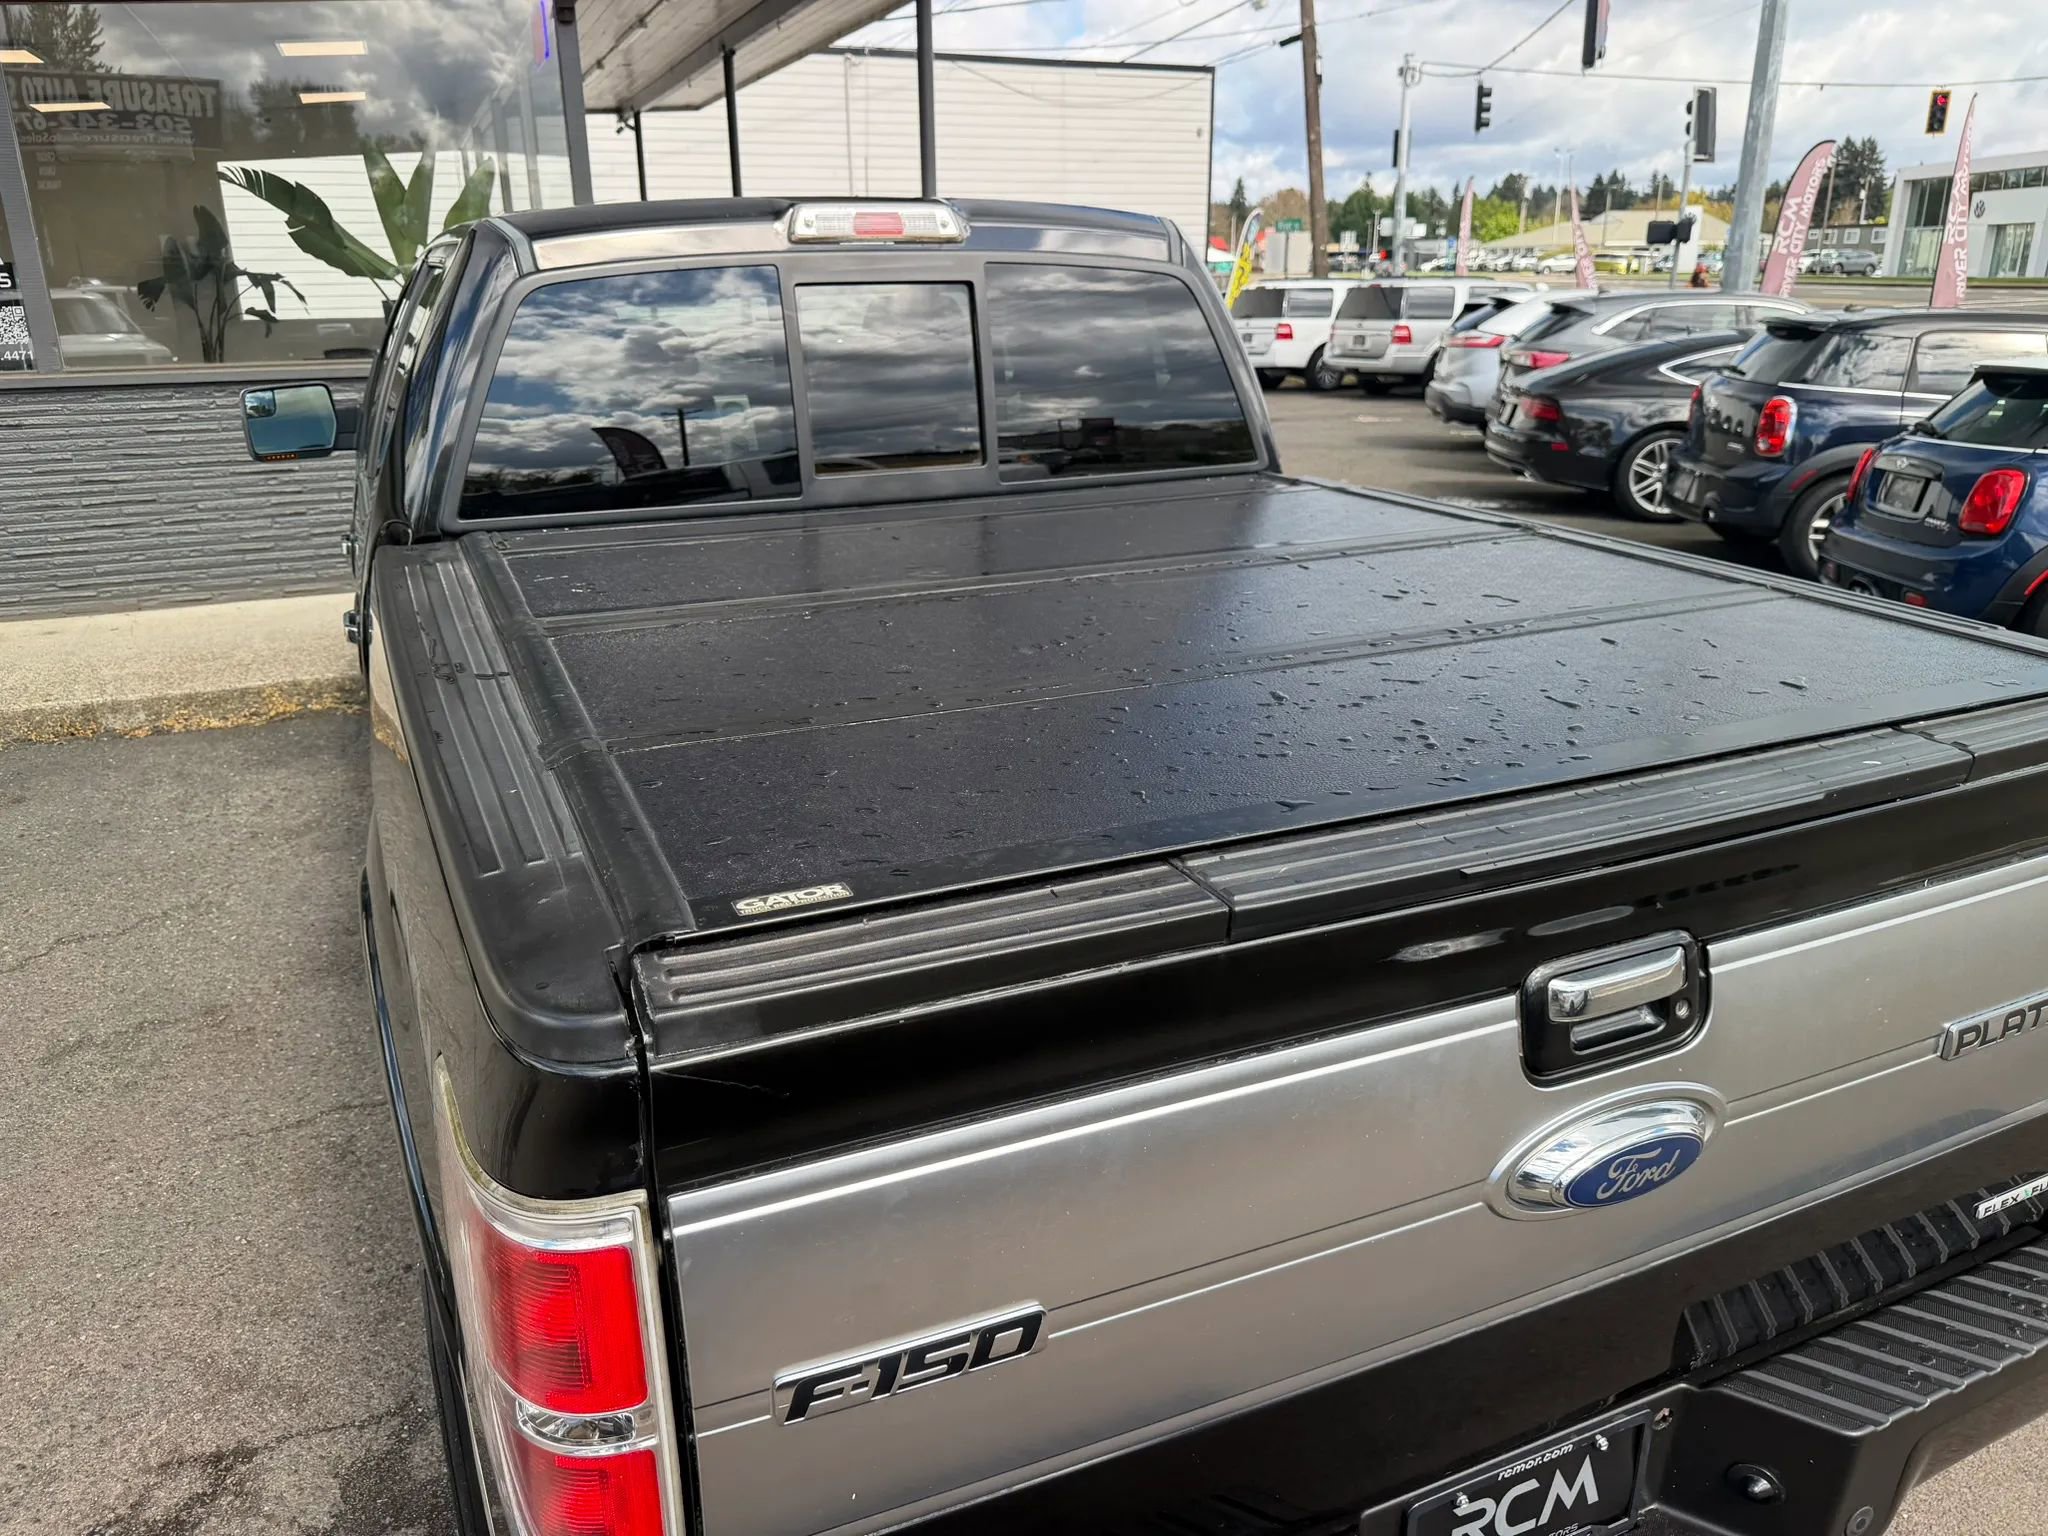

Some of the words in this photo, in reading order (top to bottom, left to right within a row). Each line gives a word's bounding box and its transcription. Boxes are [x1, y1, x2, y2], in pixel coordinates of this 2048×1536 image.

[1773, 195, 1802, 255] RCM
[1779, 254, 1798, 298] RIVER
[1790, 220, 1806, 254] CITY
[1800, 158, 1826, 217] MOTORS
[1944, 171, 1963, 245] RCM
[1955, 205, 1968, 242] CITY
[1954, 247, 1968, 298] RIVER
[736, 885, 844, 910] GATOR
[1953, 998, 2048, 1057] PLAT
[1596, 1147, 1680, 1199] Ford
[1983, 1193, 2020, 1217] FLEX
[2031, 1180, 2048, 1196] FL
[784, 1310, 1044, 1424] F-150
[1498, 1444, 1574, 1481] rcmor.com
[1451, 1454, 1600, 1536] RCM
